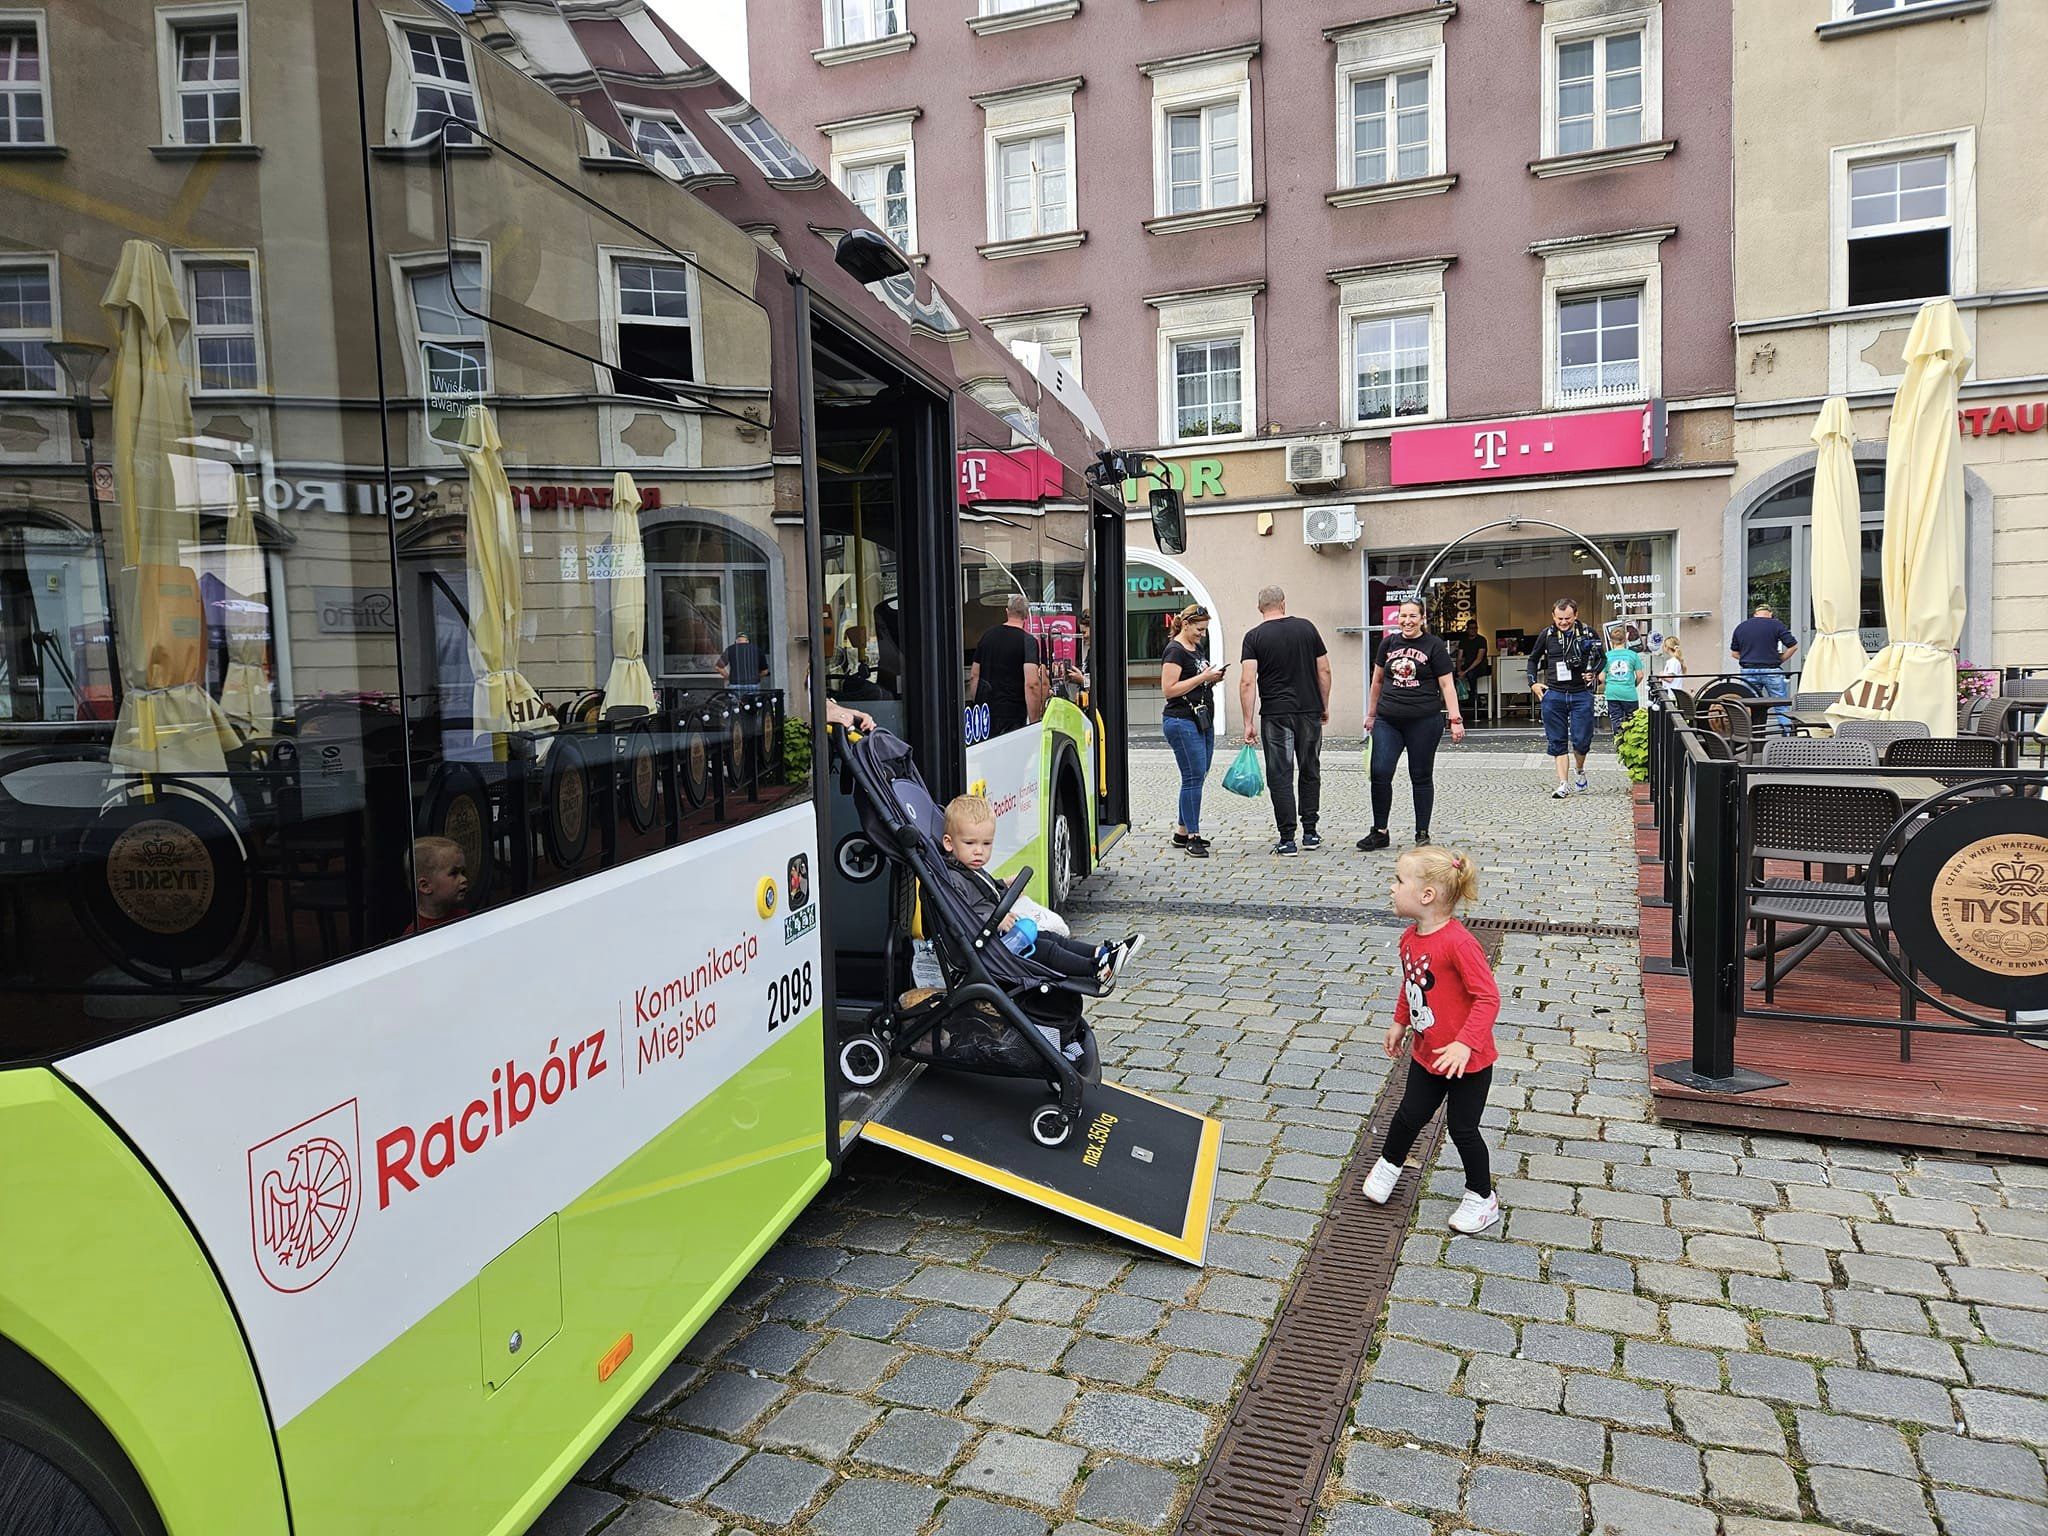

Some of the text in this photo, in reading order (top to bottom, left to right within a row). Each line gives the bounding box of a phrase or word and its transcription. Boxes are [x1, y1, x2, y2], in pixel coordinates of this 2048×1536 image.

[432, 374, 473, 400] Wyjście
[431, 395, 477, 419] awaryjne
[564, 545, 625, 554] KNCERT
[1605, 592, 1636, 602] Wyberz
[1945, 858, 1968, 887] CZTERY
[1969, 844, 1997, 860] WIEKI
[1954, 898, 2048, 927] TYSK
[1941, 896, 1964, 944] RECEPTURA
[1963, 943, 2003, 967] TYSKICH
[767, 960, 812, 1032] 2098
[638, 1001, 717, 1075] Miejska
[376, 932, 758, 1211] Racibórz Komunikacja
